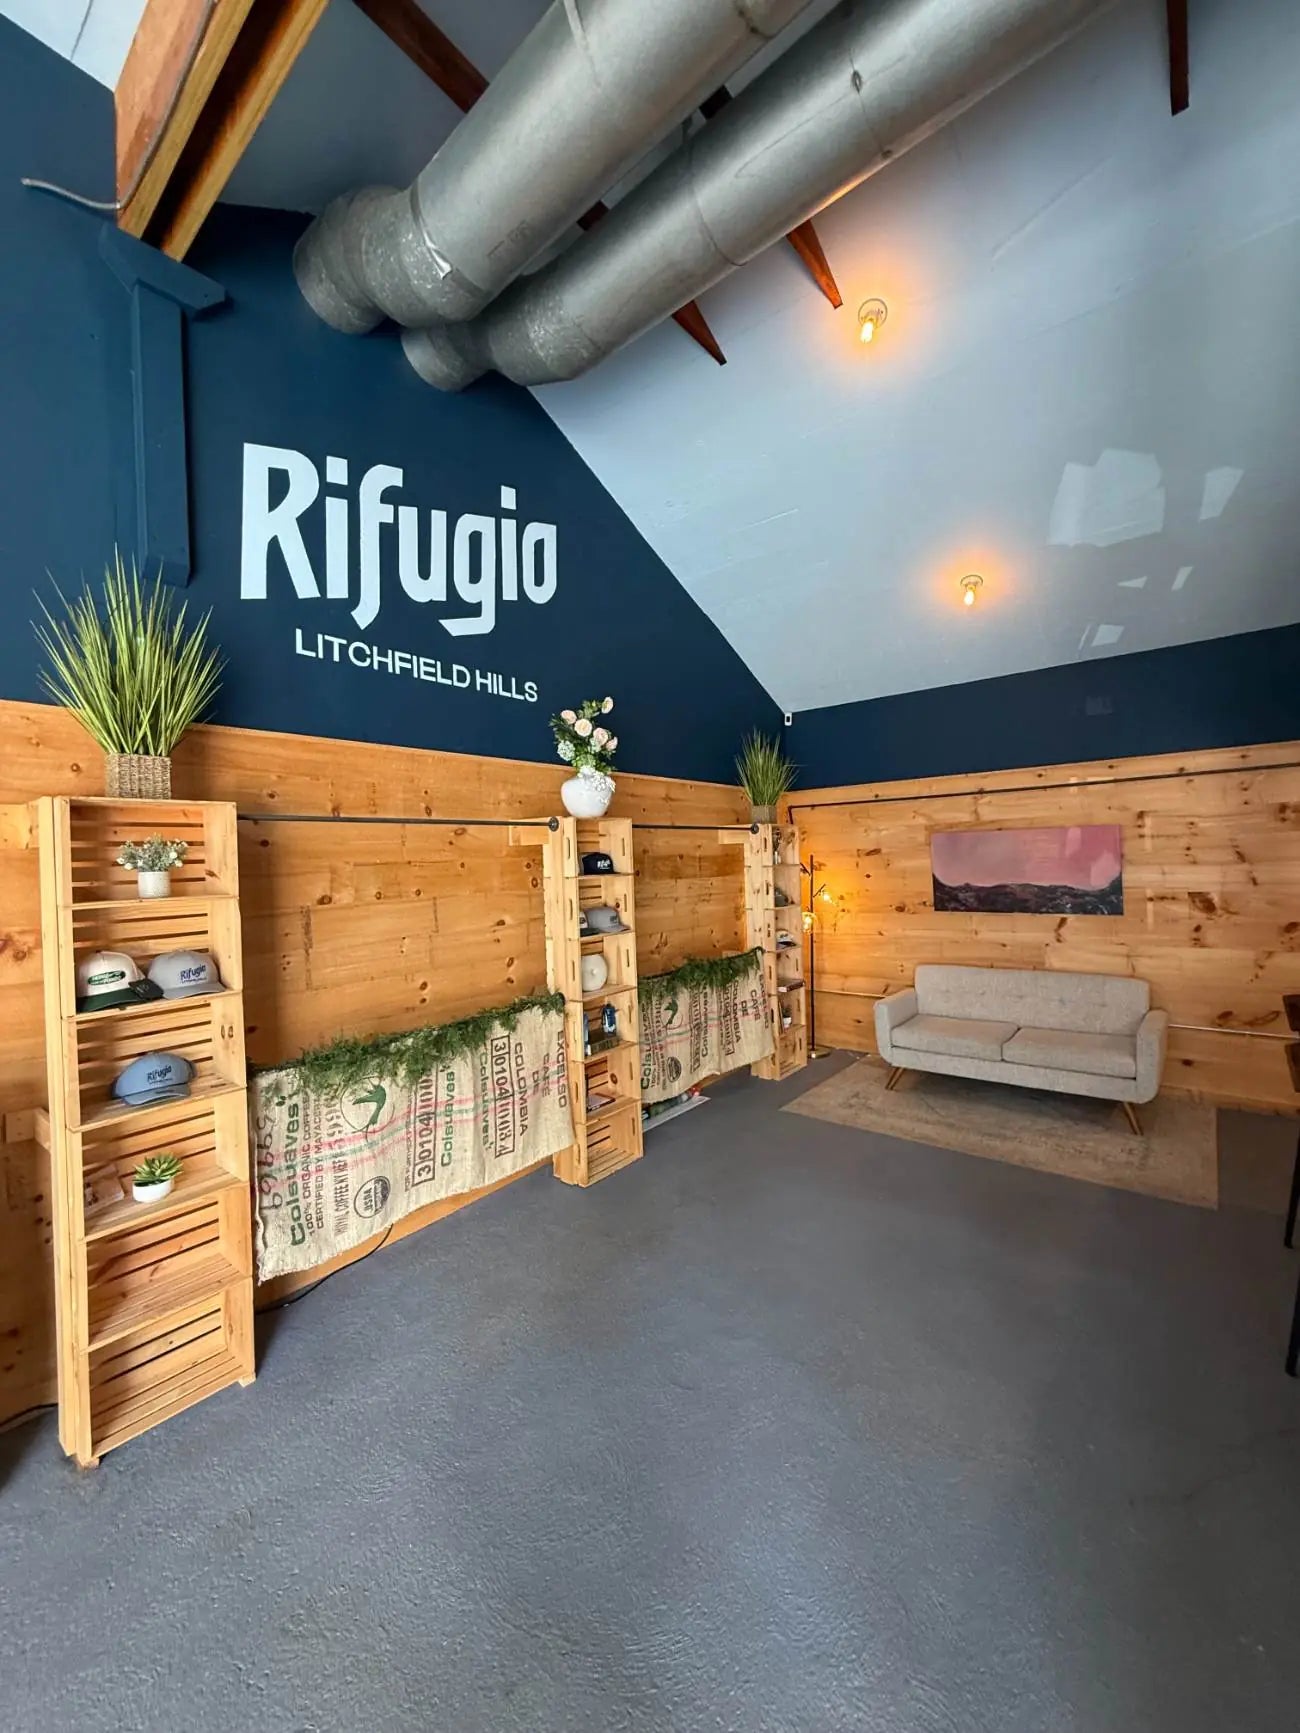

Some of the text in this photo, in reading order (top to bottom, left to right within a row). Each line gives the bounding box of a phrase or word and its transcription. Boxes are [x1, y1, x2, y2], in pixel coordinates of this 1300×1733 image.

[240, 442, 557, 637] Rifugio
[295, 628, 538, 702] LITCHFIELD HILLS
[514, 1042, 529, 1137] COLOMBIA
[556, 1030, 568, 1108] EXCELSO
[440, 1071, 456, 1168] Colsuaves
[284, 1103, 306, 1247] Colsuaves
[301, 1143, 312, 1200] ORGANIC
[314, 1175, 324, 1229] CERTIFIED
